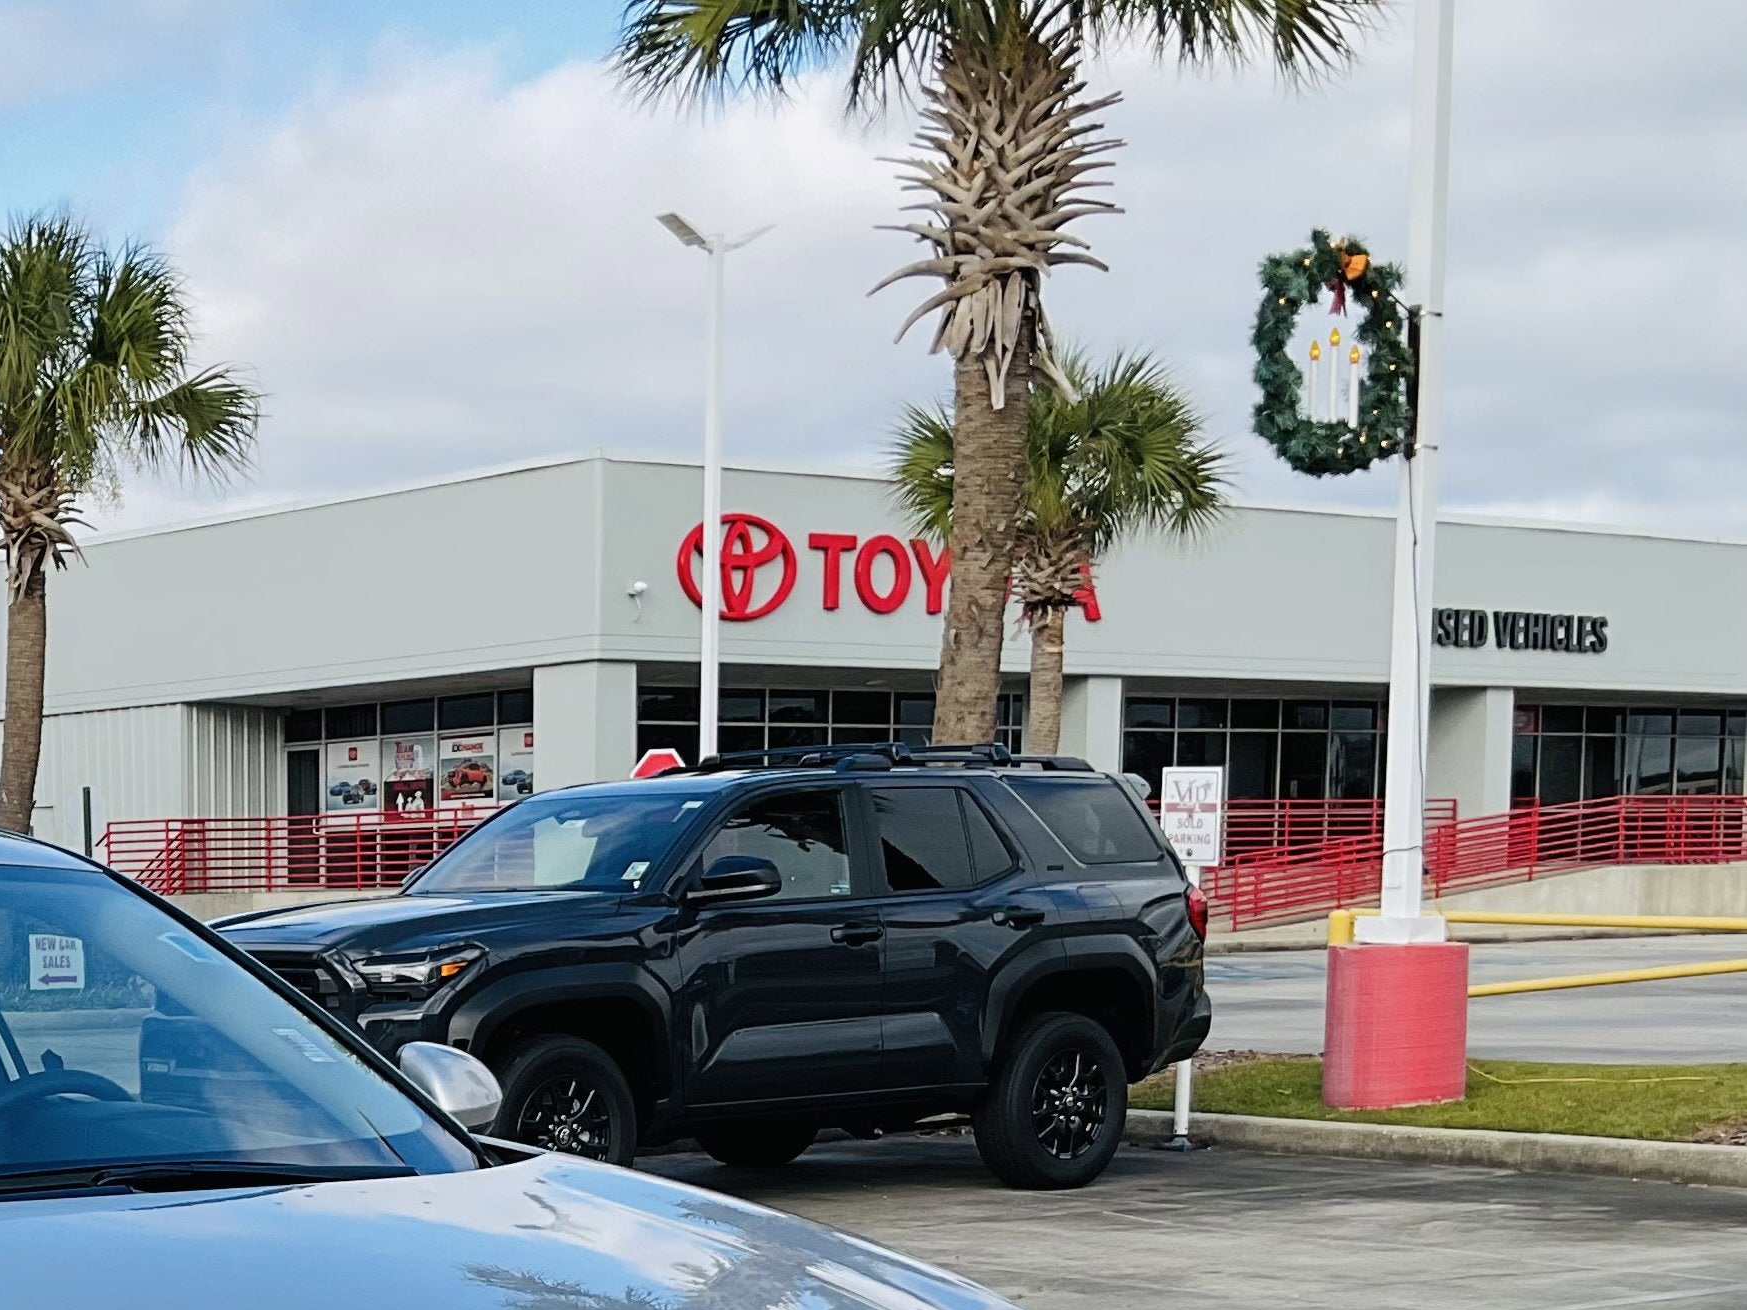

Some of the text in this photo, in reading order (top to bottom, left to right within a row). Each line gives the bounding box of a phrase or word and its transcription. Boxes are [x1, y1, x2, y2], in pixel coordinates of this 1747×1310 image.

[808, 533, 1101, 622] TOY
[1493, 611, 1608, 653] VEHICLES
[1177, 818, 1203, 829] SOLD
[1168, 833, 1211, 845] PARKING
[35, 937, 56, 951] NEW
[42, 955, 71, 969] SALES
